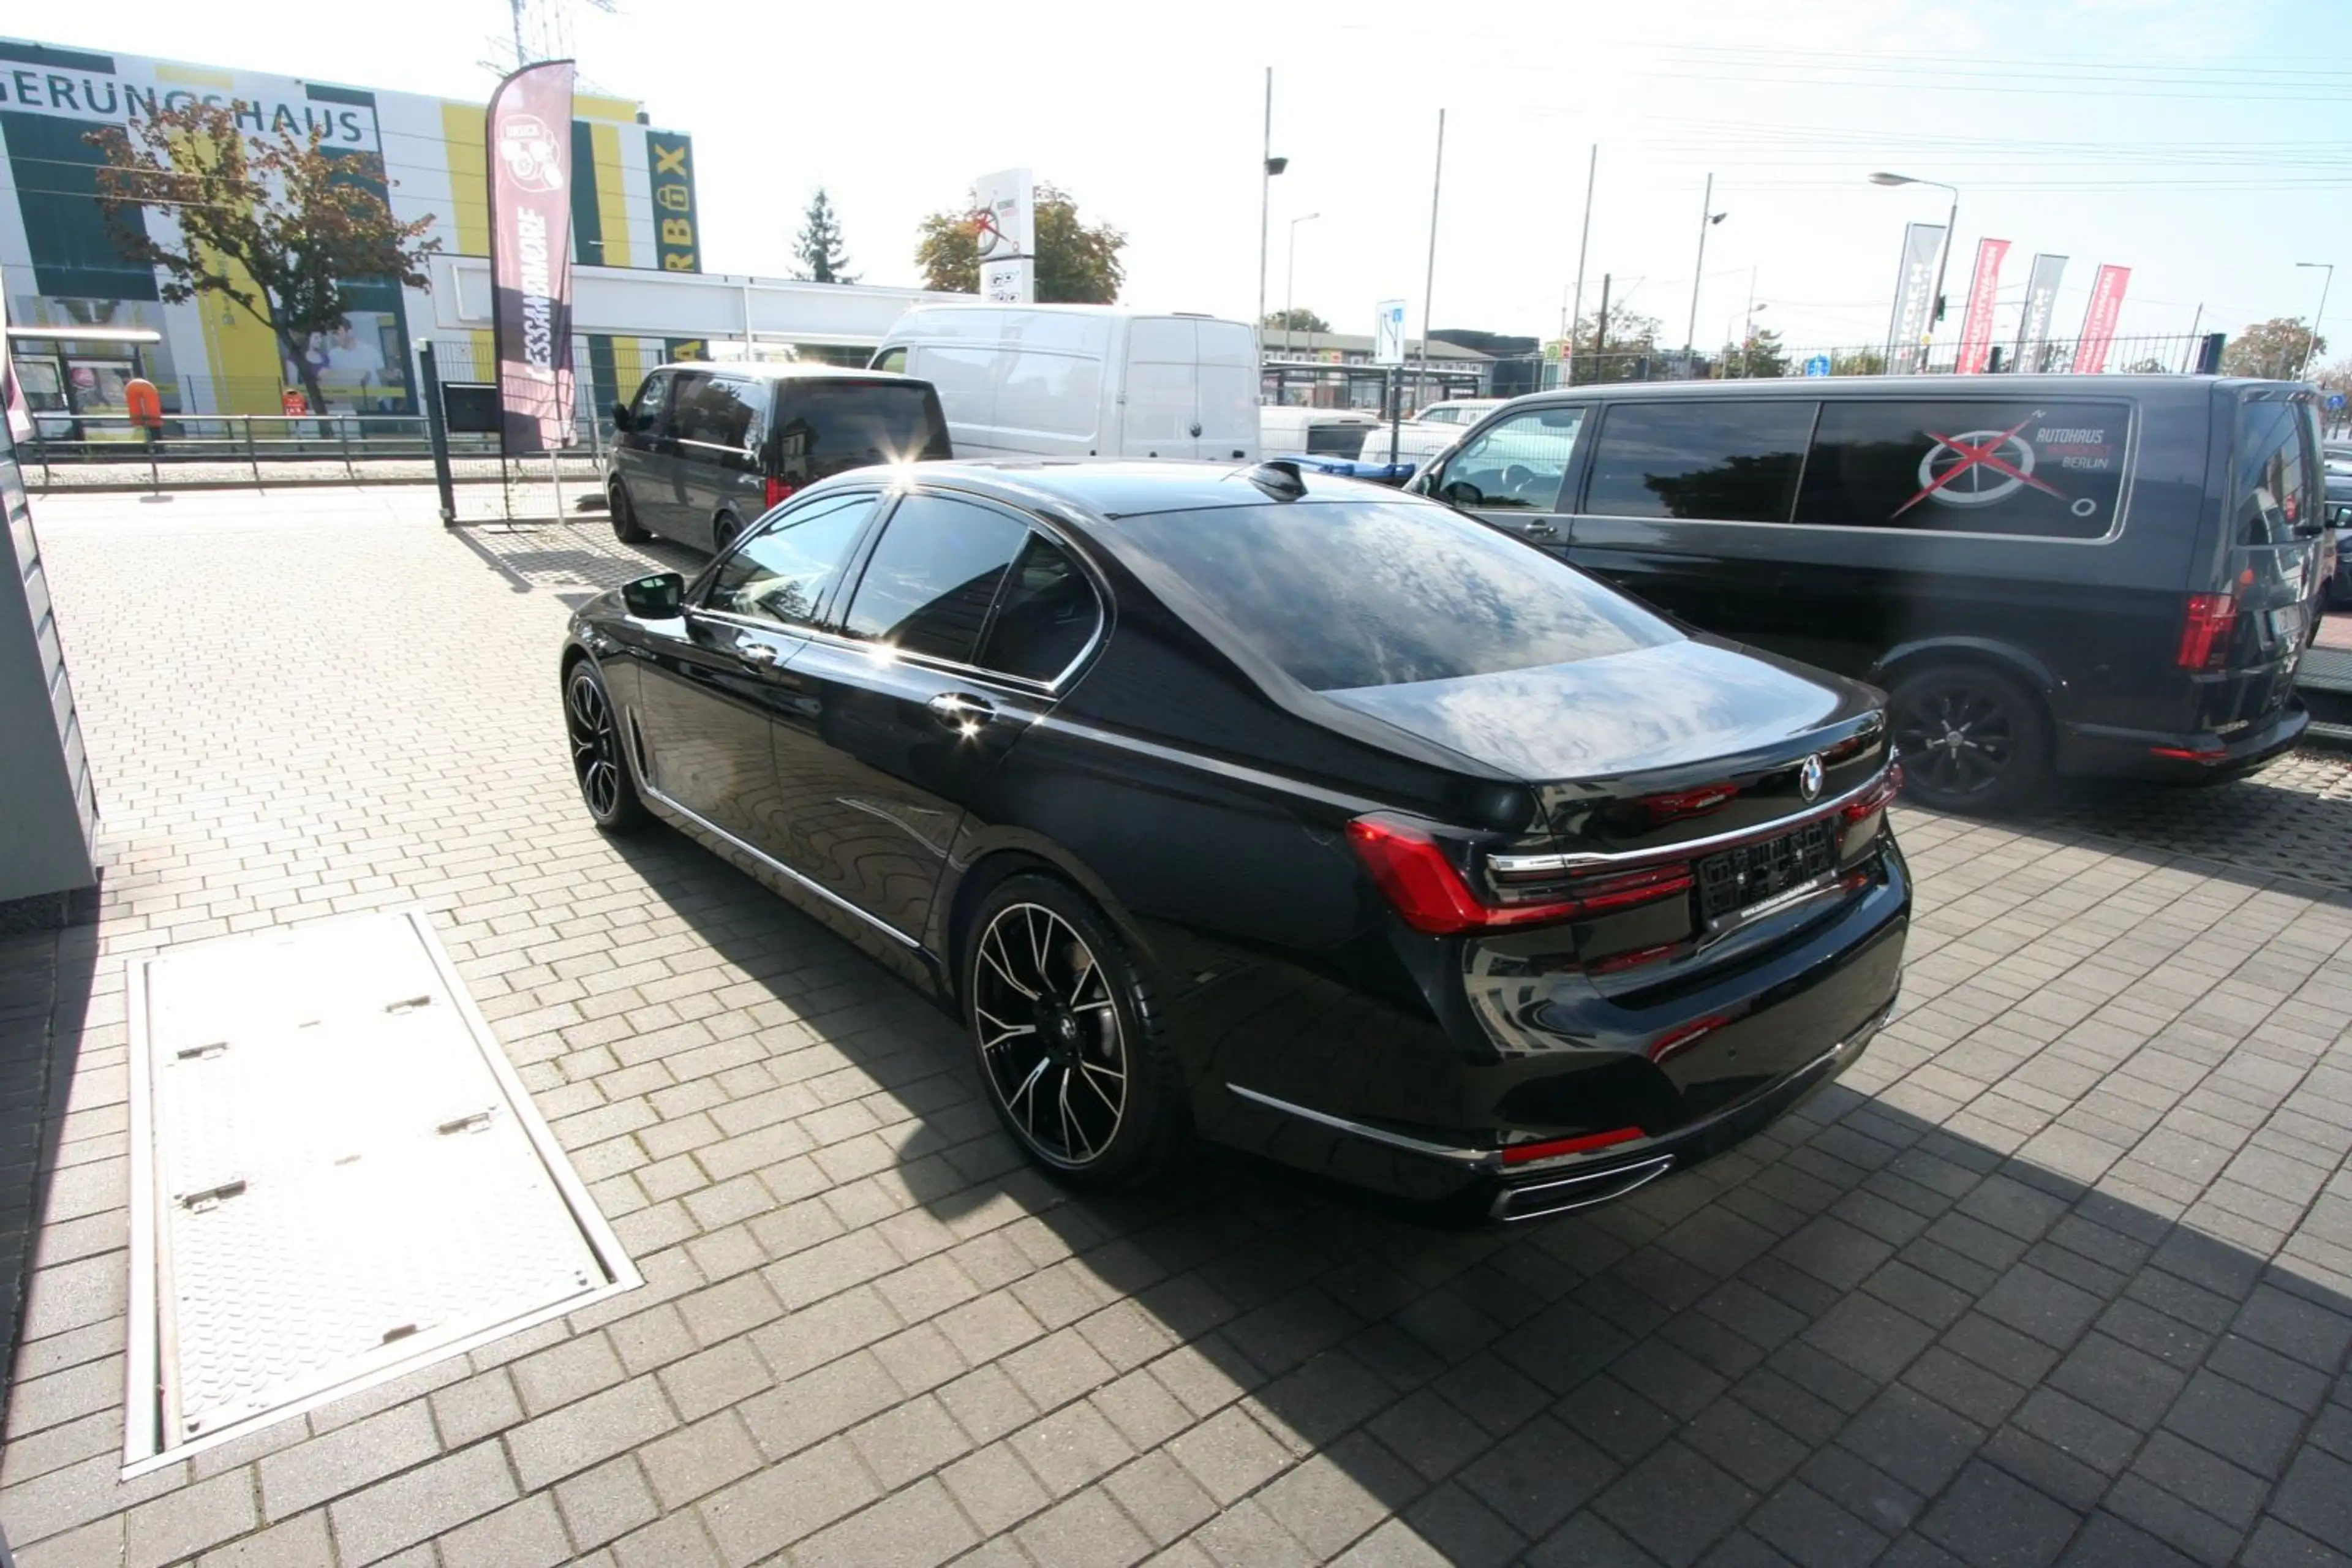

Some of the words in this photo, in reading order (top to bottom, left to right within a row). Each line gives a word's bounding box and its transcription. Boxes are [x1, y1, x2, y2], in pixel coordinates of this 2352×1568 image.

[0, 69, 362, 142] ERUNGSHAUS
[2036, 428, 2105, 444] AUTOHAUS
[2062, 456, 2109, 469] BERLIN
